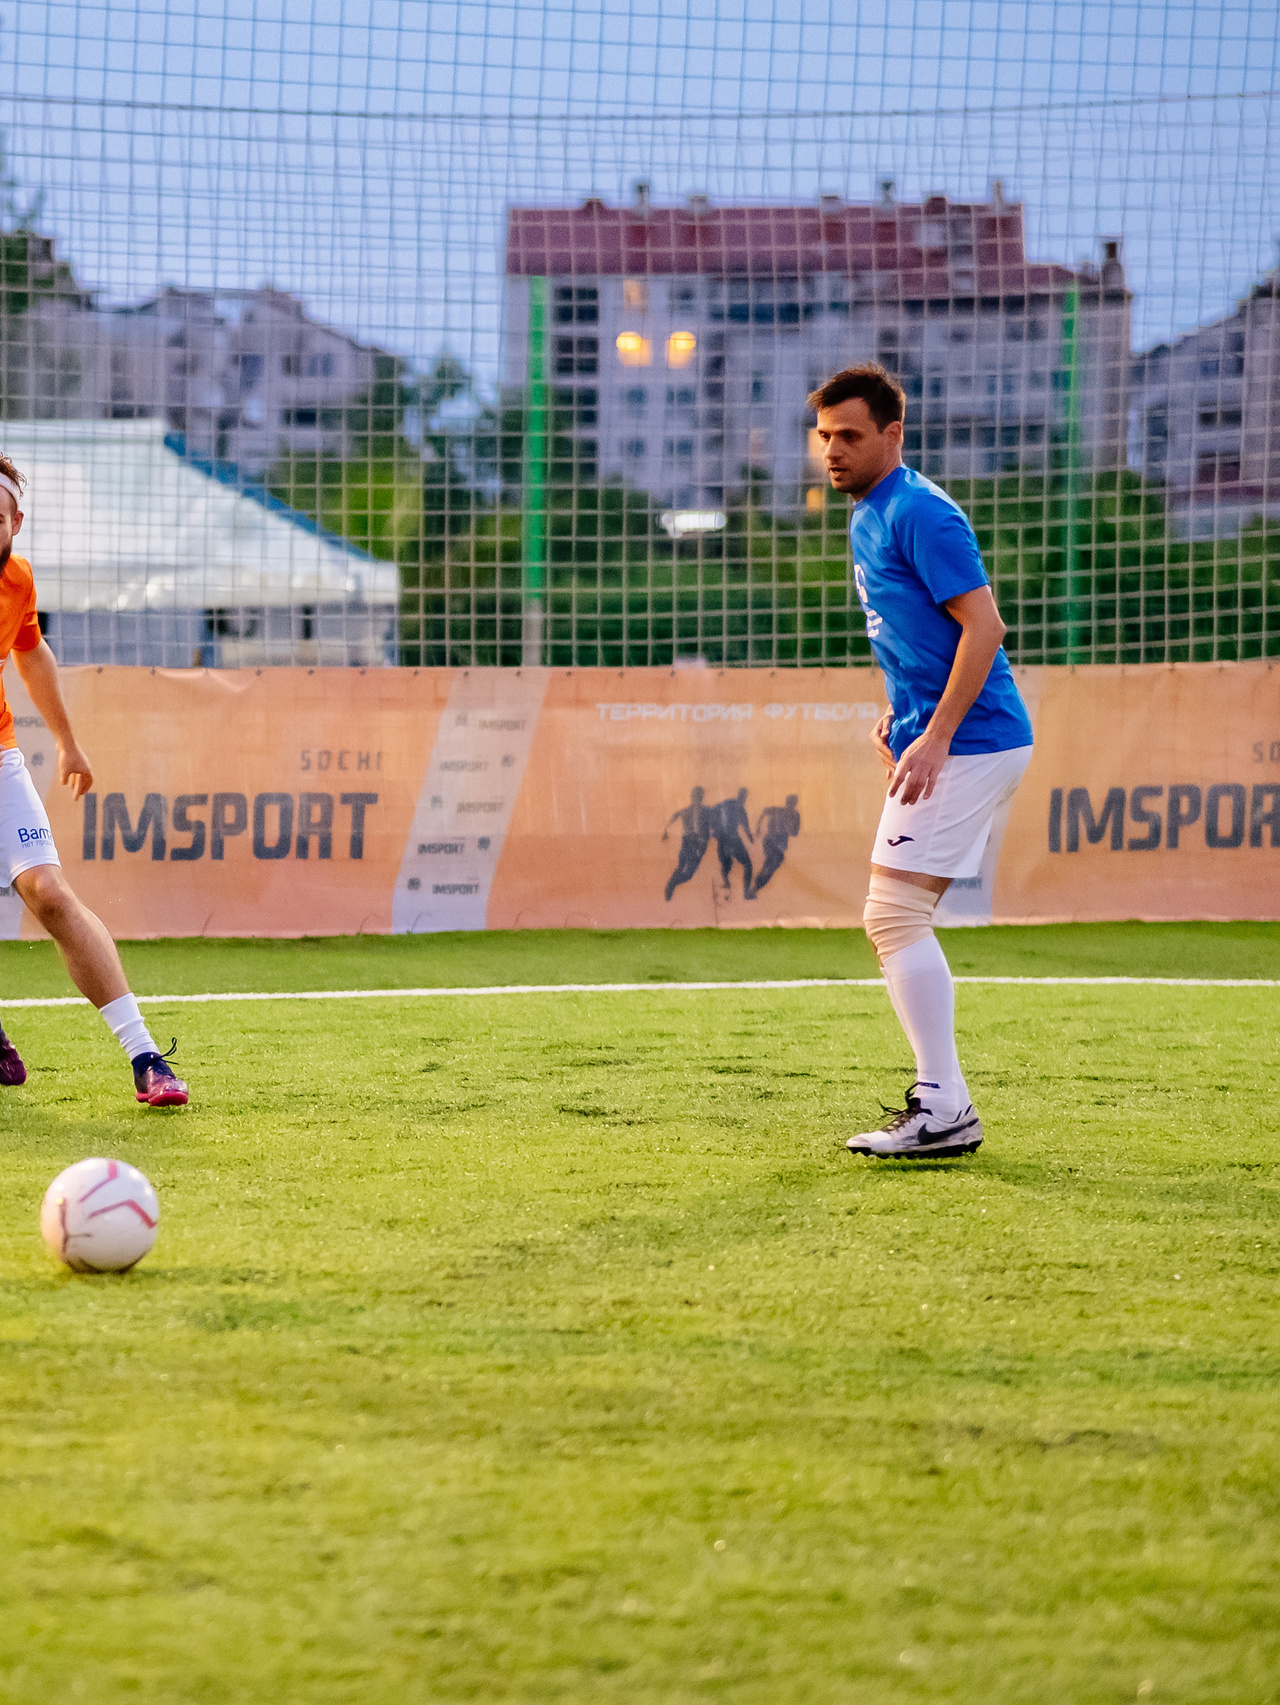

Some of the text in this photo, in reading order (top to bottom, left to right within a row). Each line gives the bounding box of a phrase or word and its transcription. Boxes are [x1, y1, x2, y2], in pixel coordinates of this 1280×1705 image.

[596, 702, 879, 723] ТЕРРИТОРИЯ ФУТБОЛА
[300, 749, 384, 772] SOCHI
[81, 792, 380, 862] IMSPORT
[417, 842, 466, 856] IMSPORT
[432, 883, 480, 896] IMSPORT
